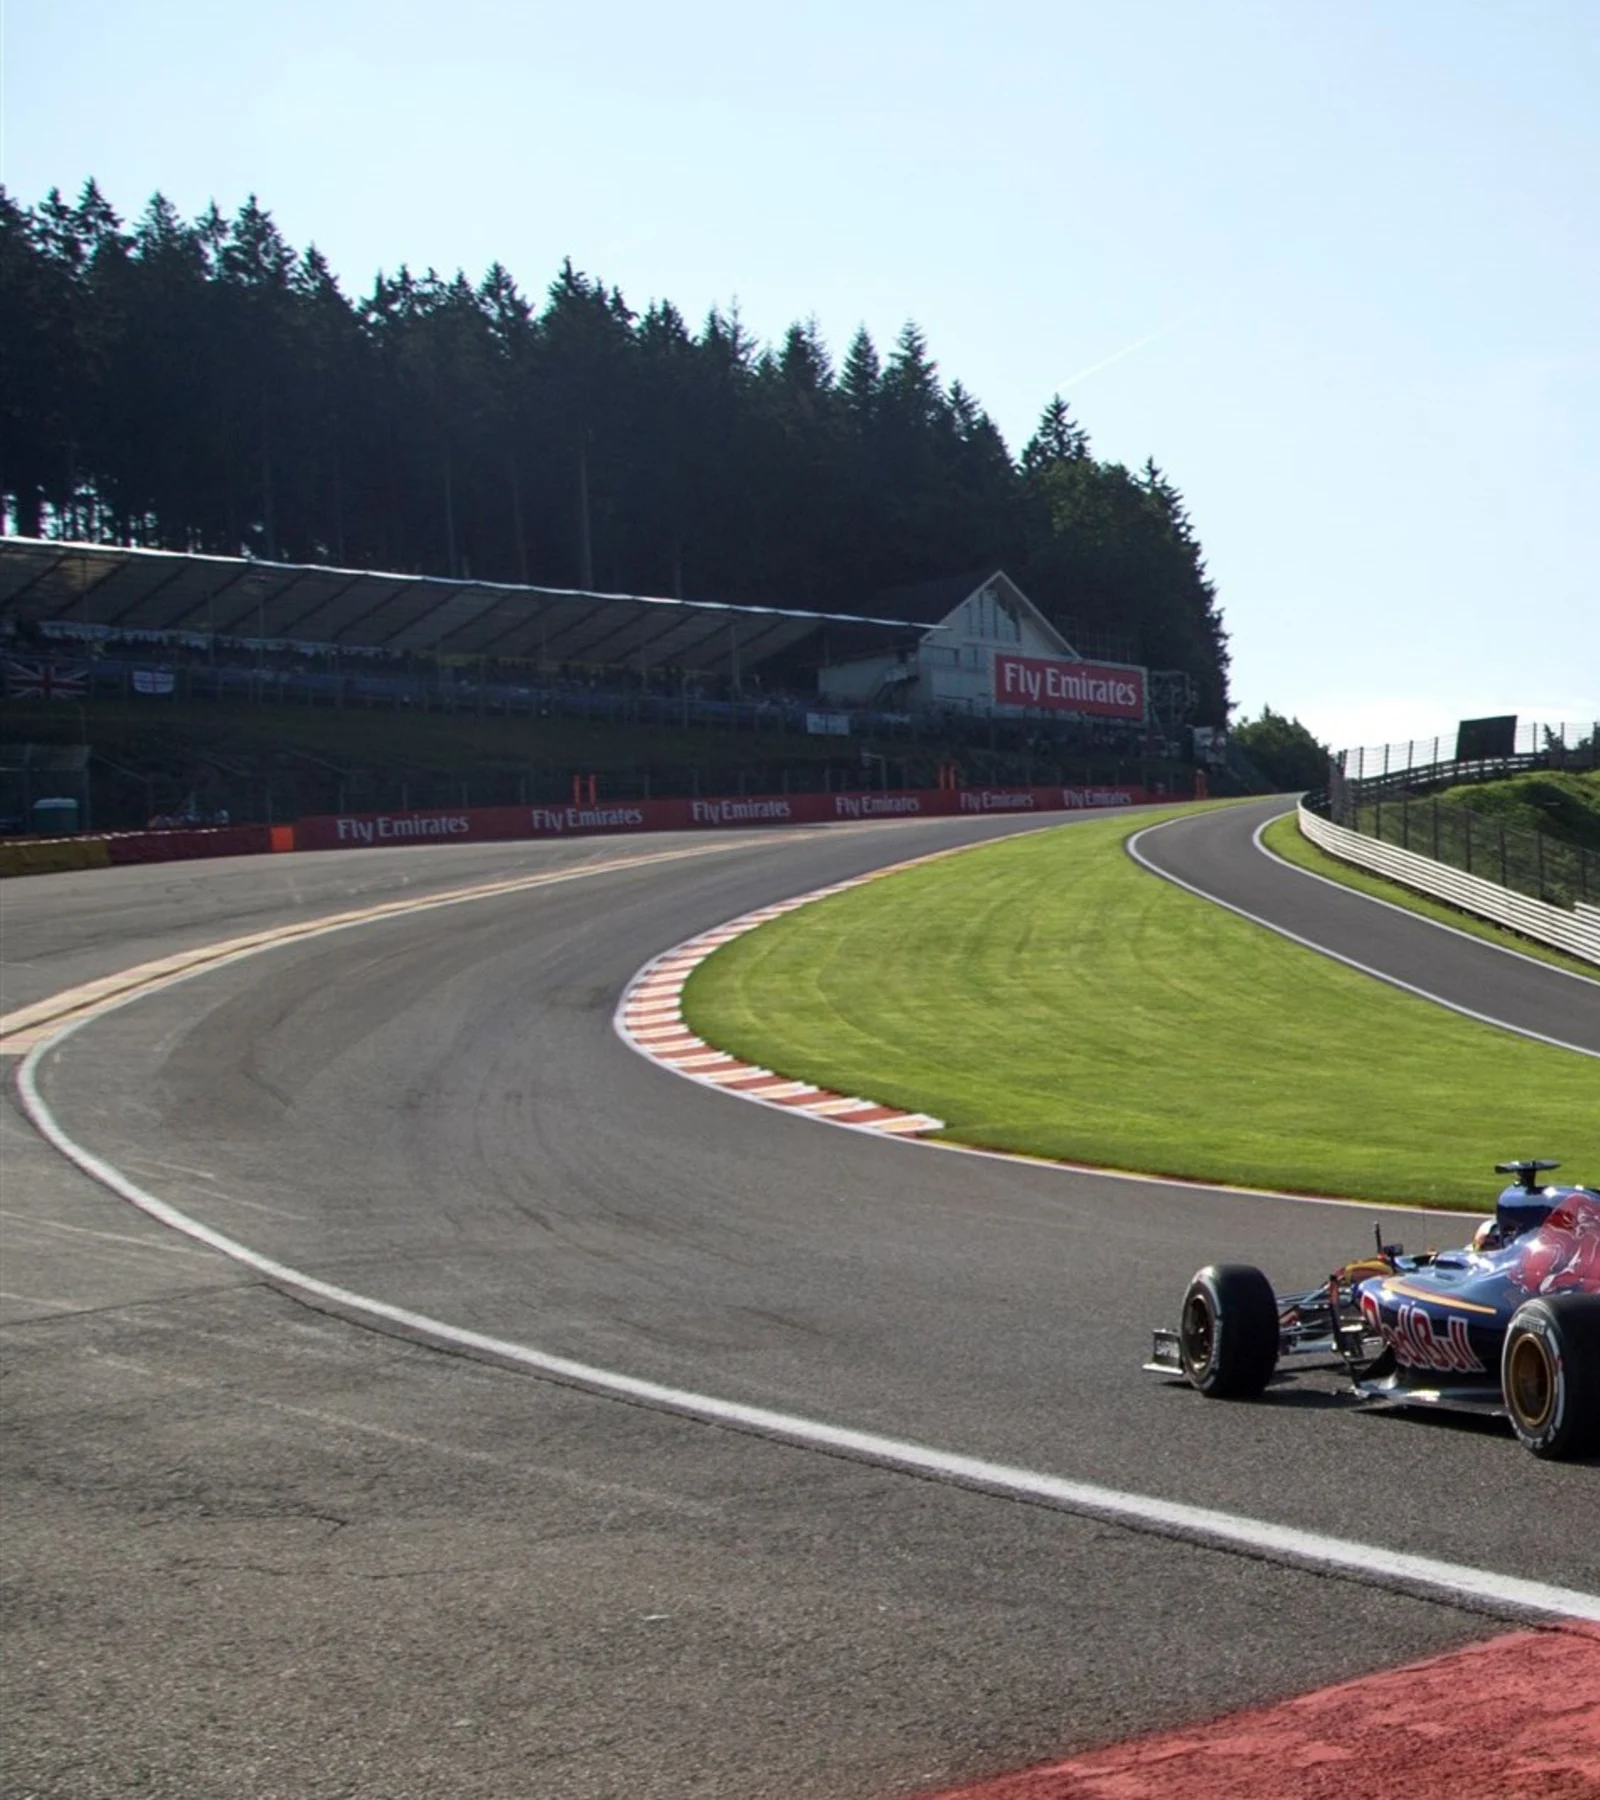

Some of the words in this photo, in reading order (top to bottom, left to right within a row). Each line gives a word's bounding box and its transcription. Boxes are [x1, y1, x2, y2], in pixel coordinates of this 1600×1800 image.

[1004, 663, 1041, 700] Fly
[1046, 668, 1136, 706] Emirates
[692, 800, 720, 824] Fly
[722, 799, 791, 820] Emirates
[836, 796, 860, 816] Fly
[862, 795, 920, 813] Emirates
[336, 818, 372, 843] Fly
[376, 815, 470, 837] Emirates
[532, 809, 563, 831] Fly
[566, 807, 644, 827] Emirates
